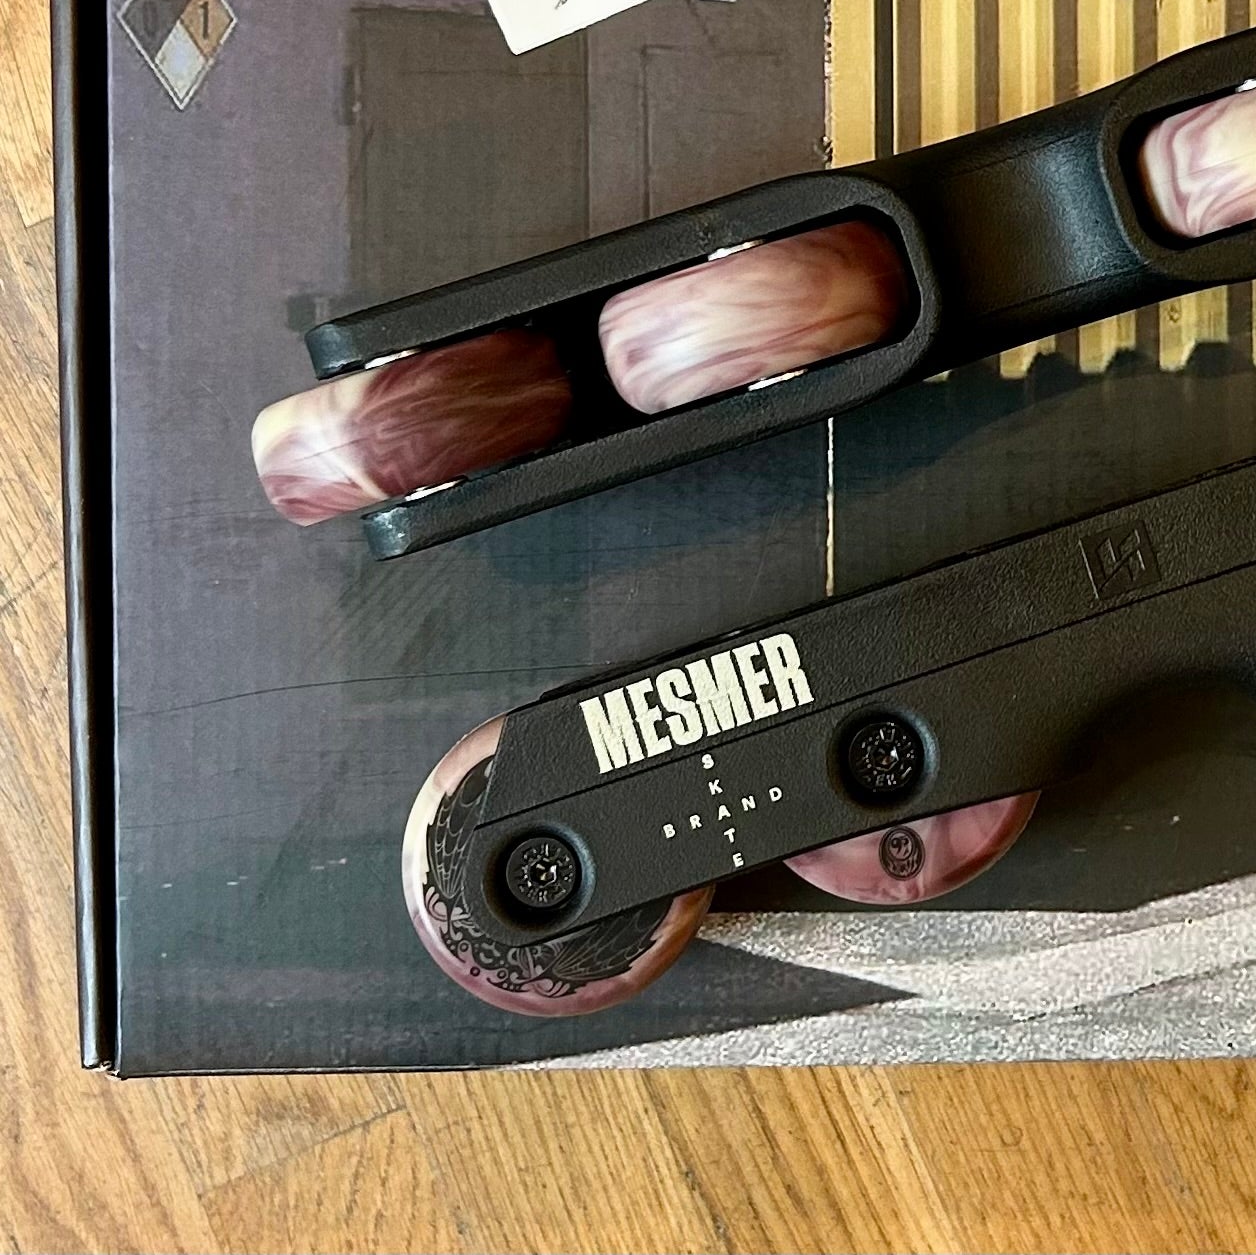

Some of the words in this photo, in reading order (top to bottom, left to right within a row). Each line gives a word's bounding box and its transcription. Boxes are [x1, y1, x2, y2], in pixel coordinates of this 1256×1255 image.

[198, 0, 210, 41] 1
[579, 633, 815, 774] MESMER
[662, 786, 783, 839] BRAND
[701, 753, 745, 868] SKATE
